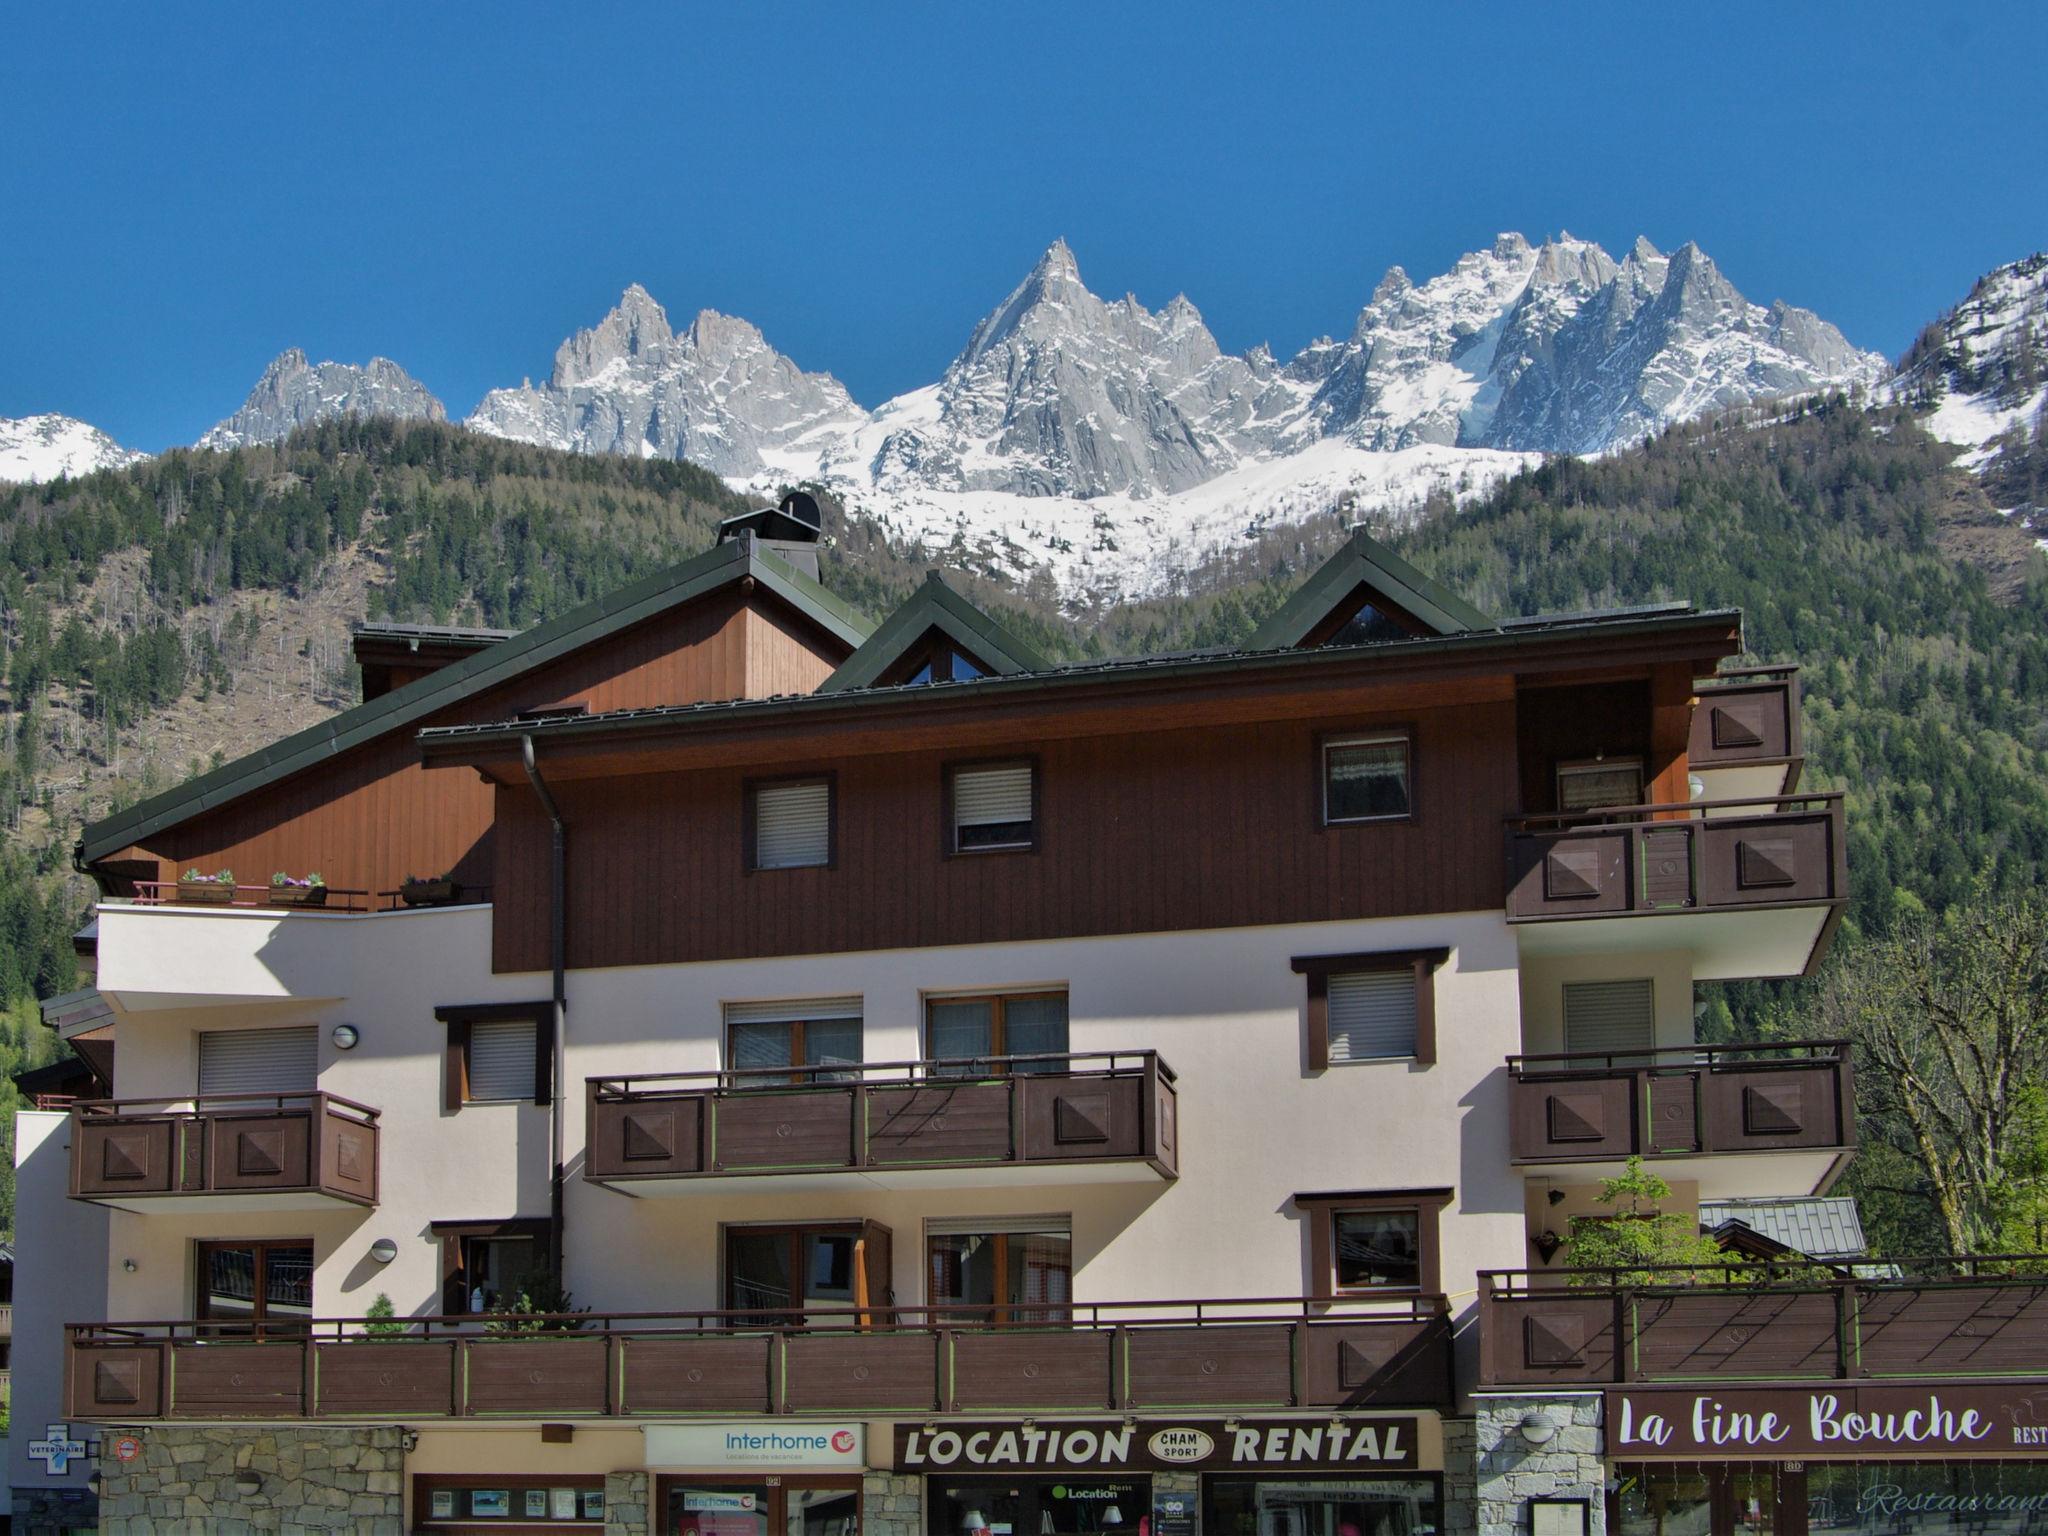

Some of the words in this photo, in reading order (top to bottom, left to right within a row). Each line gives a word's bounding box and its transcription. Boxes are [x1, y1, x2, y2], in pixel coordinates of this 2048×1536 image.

[1619, 1397, 1673, 1446] La
[1692, 1397, 1791, 1445] Fine
[1810, 1394, 1993, 1443] Bouche
[726, 1433, 827, 1449] Interhome
[904, 1430, 1131, 1465] LOCATION
[1164, 1448, 1198, 1457] SPORT
[1232, 1427, 1407, 1462] RENTAL
[685, 1497, 738, 1507] Interhome
[1068, 1488, 1118, 1499] Location
[1857, 1483, 2048, 1514] Restaurant
